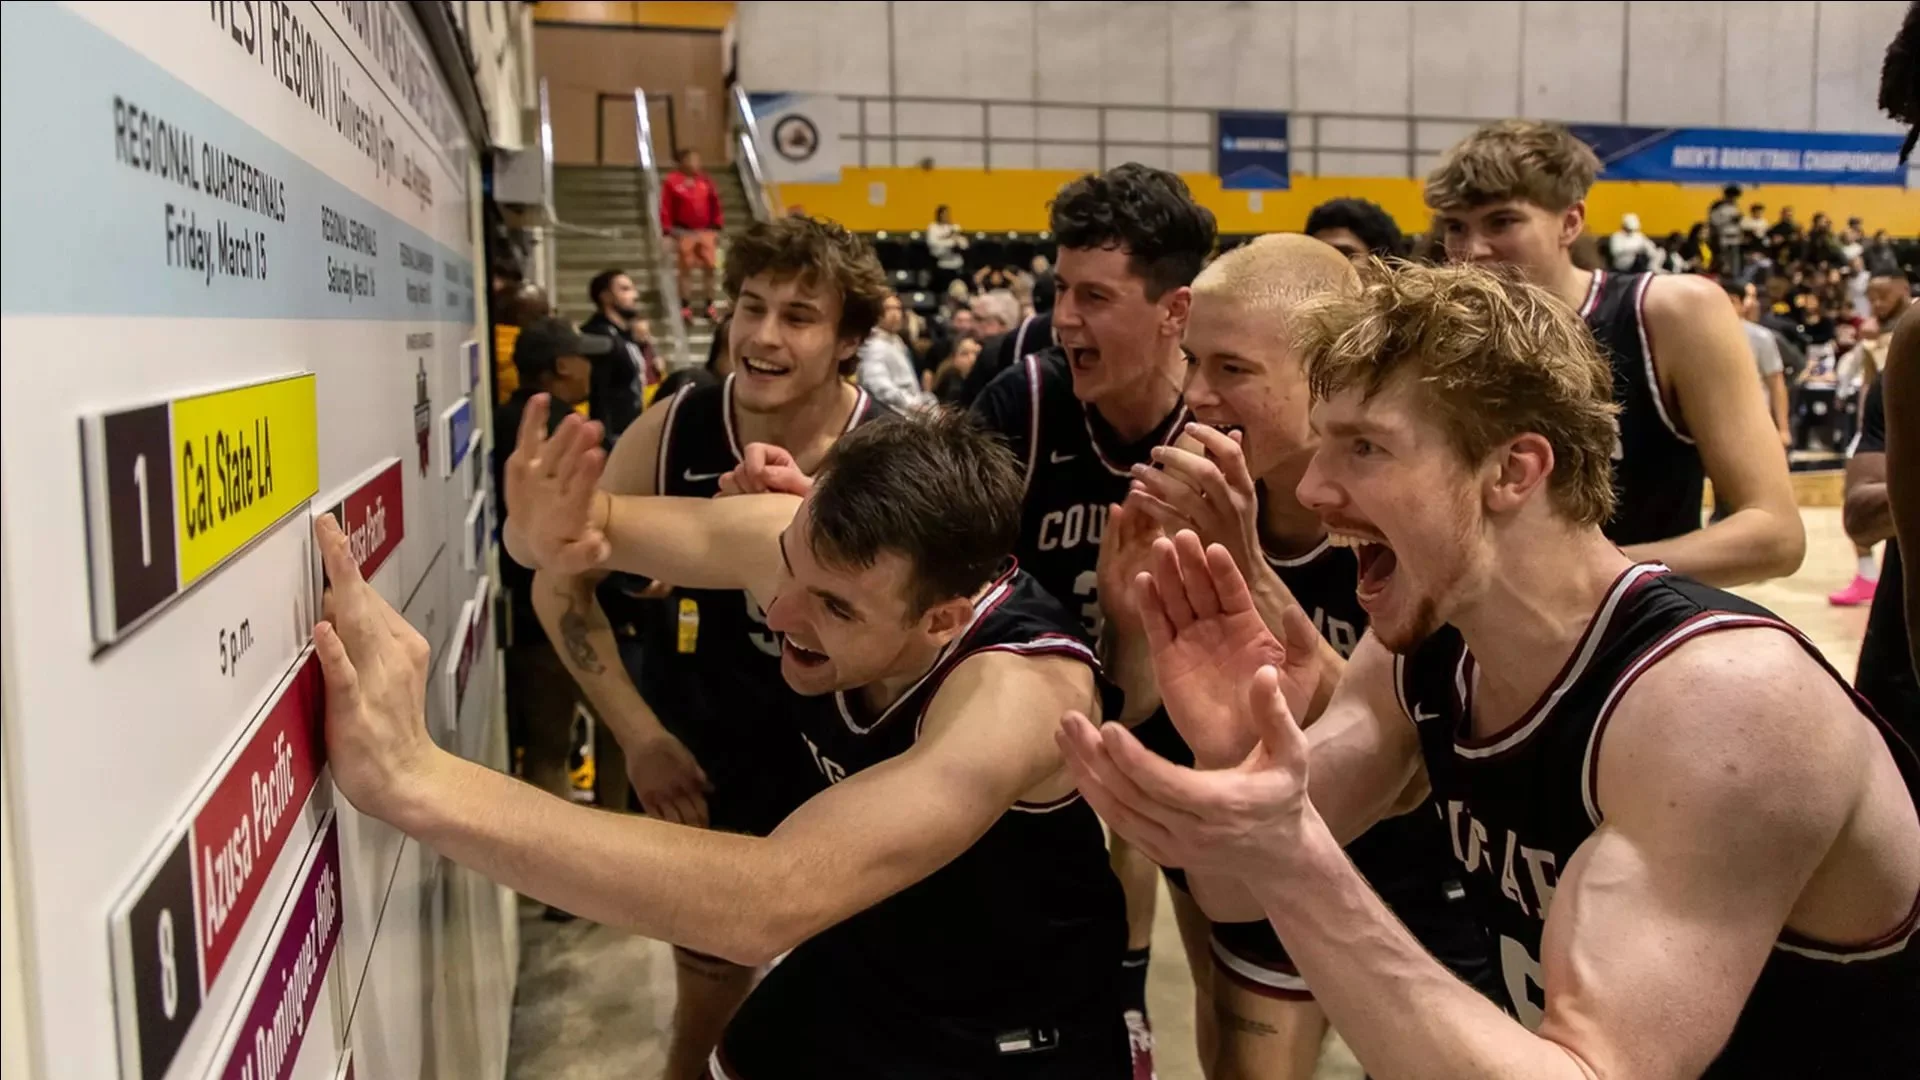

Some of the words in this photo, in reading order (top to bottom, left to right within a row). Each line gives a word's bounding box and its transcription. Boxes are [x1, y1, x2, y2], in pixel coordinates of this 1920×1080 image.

[269, 0, 326, 119] REGION
[113, 95, 199, 191] REGIONAL
[202, 141, 286, 223] QUARTERFINALS
[1672, 145, 1717, 169] MEN'S
[1719, 147, 1801, 171] BASKETBALL
[1803, 149, 1901, 174] CHAMPIONSHIP
[165, 202, 215, 287] Friday,
[217, 218, 253, 280] March
[255, 231, 267, 280] 15
[133, 453, 151, 568] 1
[182, 433, 214, 540] Cal
[215, 429, 254, 522] State
[255, 416, 274, 500] LA
[218, 627, 228, 676] 5
[230, 617, 254, 678] p.m.
[157, 908, 179, 1021] 8
[204, 812, 253, 948] Azusa
[251, 730, 295, 858] Pacific
[255, 917, 318, 1080] Dominguez
[314, 862, 337, 954] Hills
